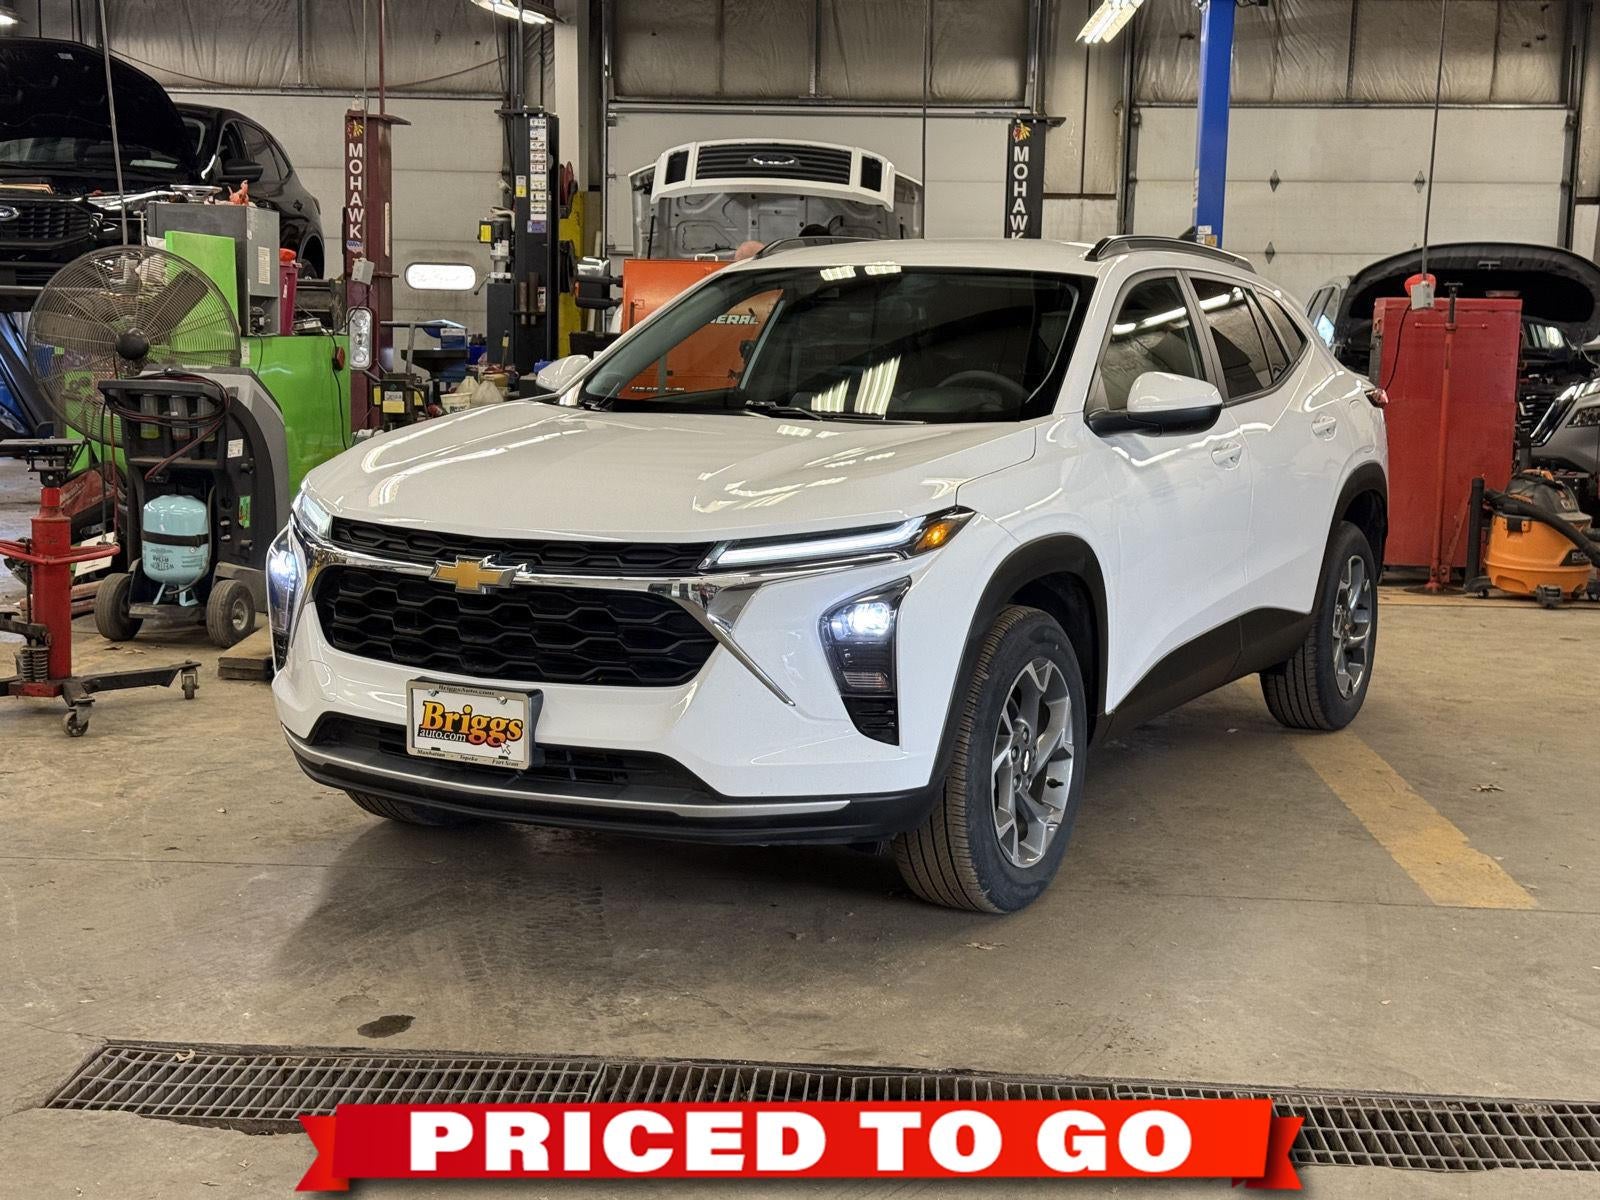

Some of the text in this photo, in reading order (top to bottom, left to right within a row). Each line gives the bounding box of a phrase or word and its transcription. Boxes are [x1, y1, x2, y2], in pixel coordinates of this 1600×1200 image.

[348, 142, 364, 239] MOHAWK
[710, 314, 759, 325] ERAL
[420, 700, 524, 748] Briggs
[420, 728, 466, 742] auto.com
